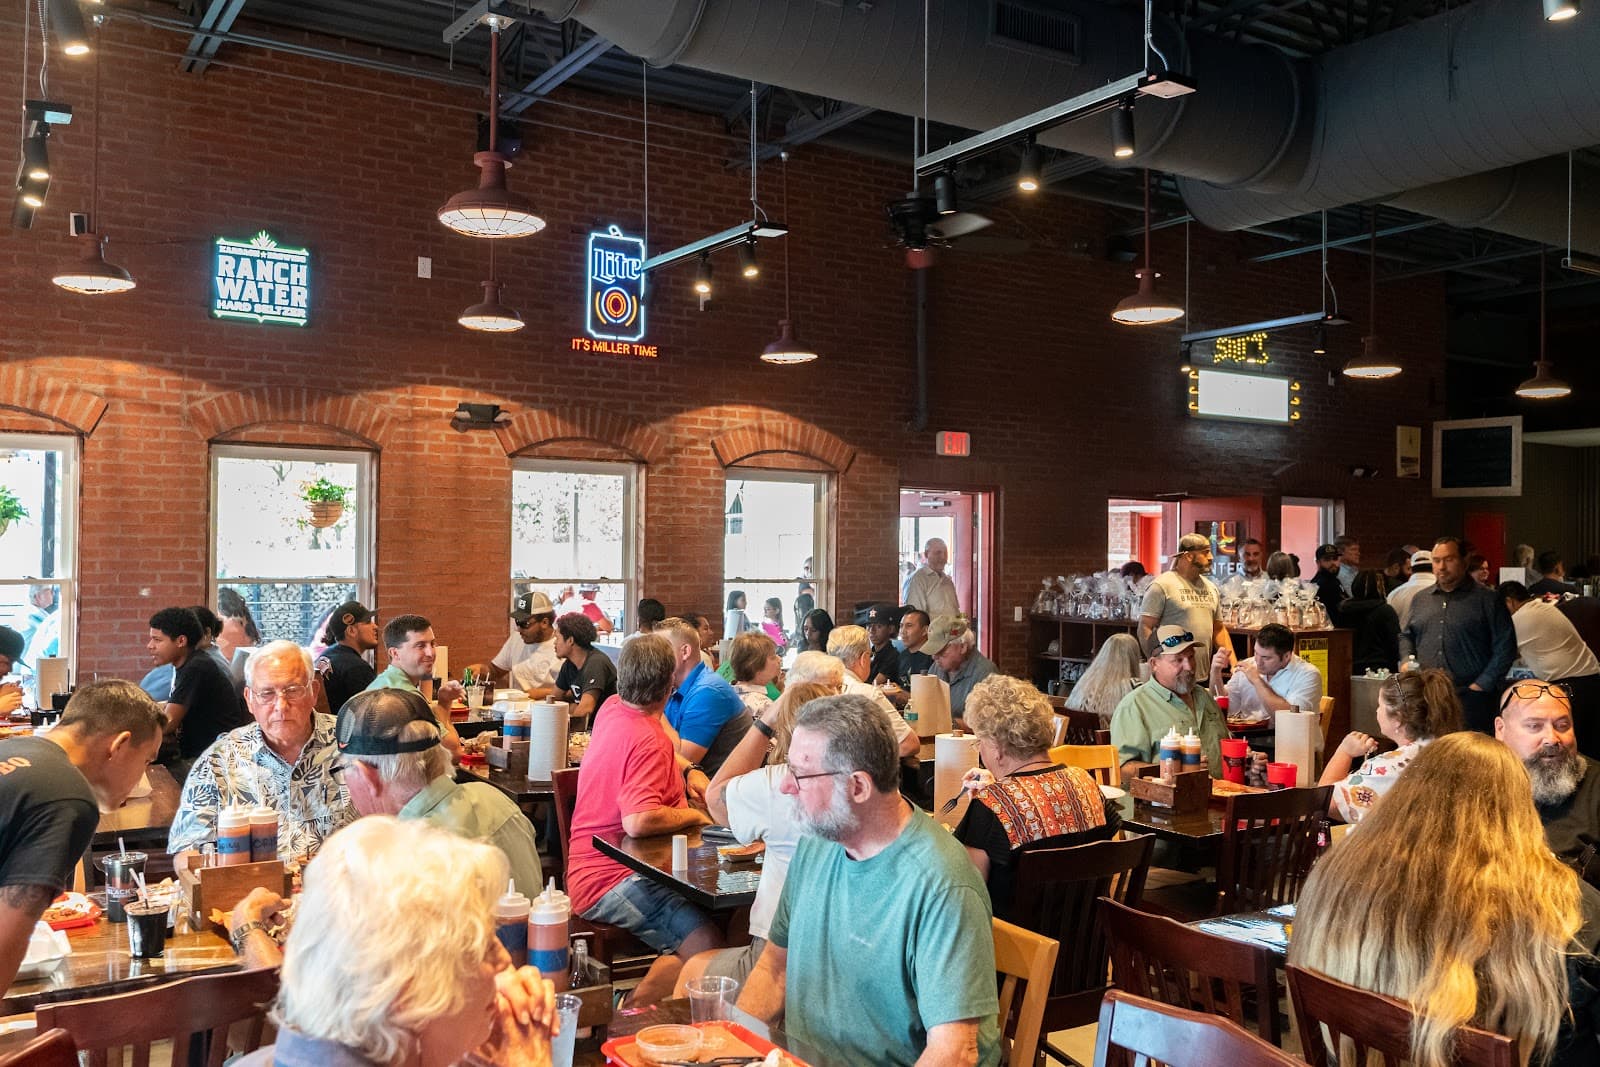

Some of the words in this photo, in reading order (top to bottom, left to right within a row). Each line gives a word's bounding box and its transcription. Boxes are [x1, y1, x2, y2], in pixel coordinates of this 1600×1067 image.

[218, 255, 307, 286] RANCH
[592, 248, 641, 284] Lite
[216, 277, 307, 308] WATER
[217, 299, 252, 312] HARD
[572, 338, 591, 351] IT'S
[592, 341, 630, 355] MILLER
[633, 344, 658, 358] TIME
[944, 432, 967, 455] EXIT
